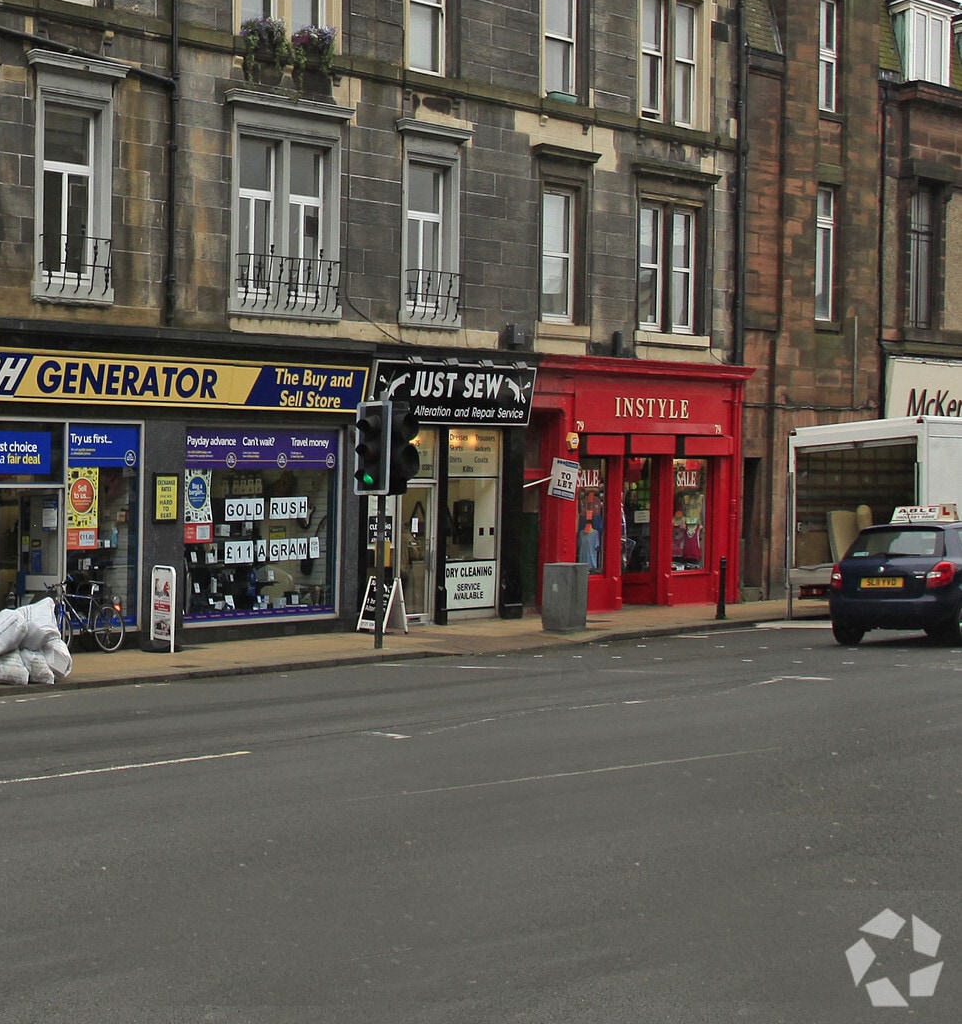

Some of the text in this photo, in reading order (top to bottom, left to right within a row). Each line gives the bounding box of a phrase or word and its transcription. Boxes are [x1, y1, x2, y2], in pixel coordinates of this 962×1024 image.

[37, 360, 218, 399] GENERATOR
[275, 367, 353, 391] The Buy and
[410, 371, 504, 400] JUST SEW
[279, 390, 341, 408] Sell Store
[414, 405, 524, 421] Alteration and Repair Service
[615, 397, 689, 419] INSTYLE
[576, 421, 585, 431] 79
[714, 425, 722, 434] 79
[70, 433, 83, 446] Try
[83, 436, 93, 444] us
[187, 435, 237, 448] Payday advance
[242, 436, 276, 447] Can't wait?
[290, 437, 330, 449] Travel money
[9, 441, 38, 453] choice
[0, 456, 5, 464] a
[7, 453, 21, 465] fair
[22, 453, 41, 465] deal
[463, 465, 474, 473] Kilts
[561, 472, 572, 480] TO
[577, 470, 599, 487] SALE
[676, 471, 697, 486] SALE
[78, 484, 87, 492] Sell
[557, 479, 573, 489] LET
[226, 501, 307, 517] GOLD RUSH
[942, 507, 950, 515] L
[226, 543, 307, 559] £11 A GRAM
[446, 566, 493, 578] DRY CLEANING
[457, 583, 481, 592] SERVICE
[454, 591, 484, 600] AVAILABLE
